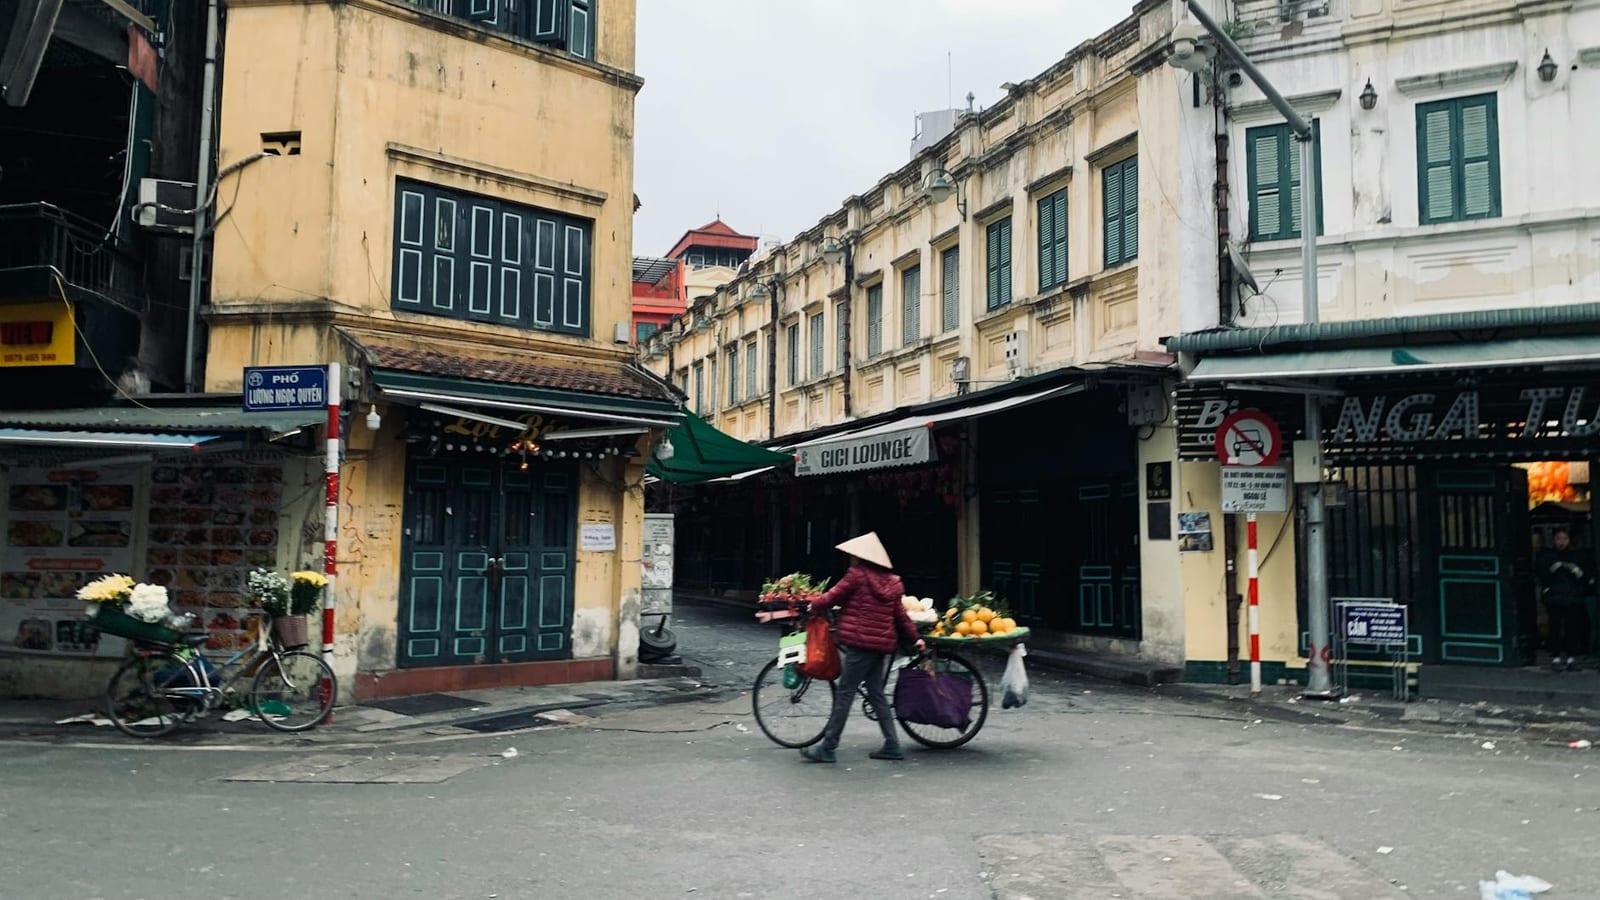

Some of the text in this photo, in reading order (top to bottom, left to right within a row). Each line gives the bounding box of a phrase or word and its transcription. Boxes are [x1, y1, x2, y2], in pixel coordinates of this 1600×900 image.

[272, 372, 299, 384] PHỐ
[275, 388, 296, 406] NGỌC
[821, 437, 912, 468] CICI LOUNGE
